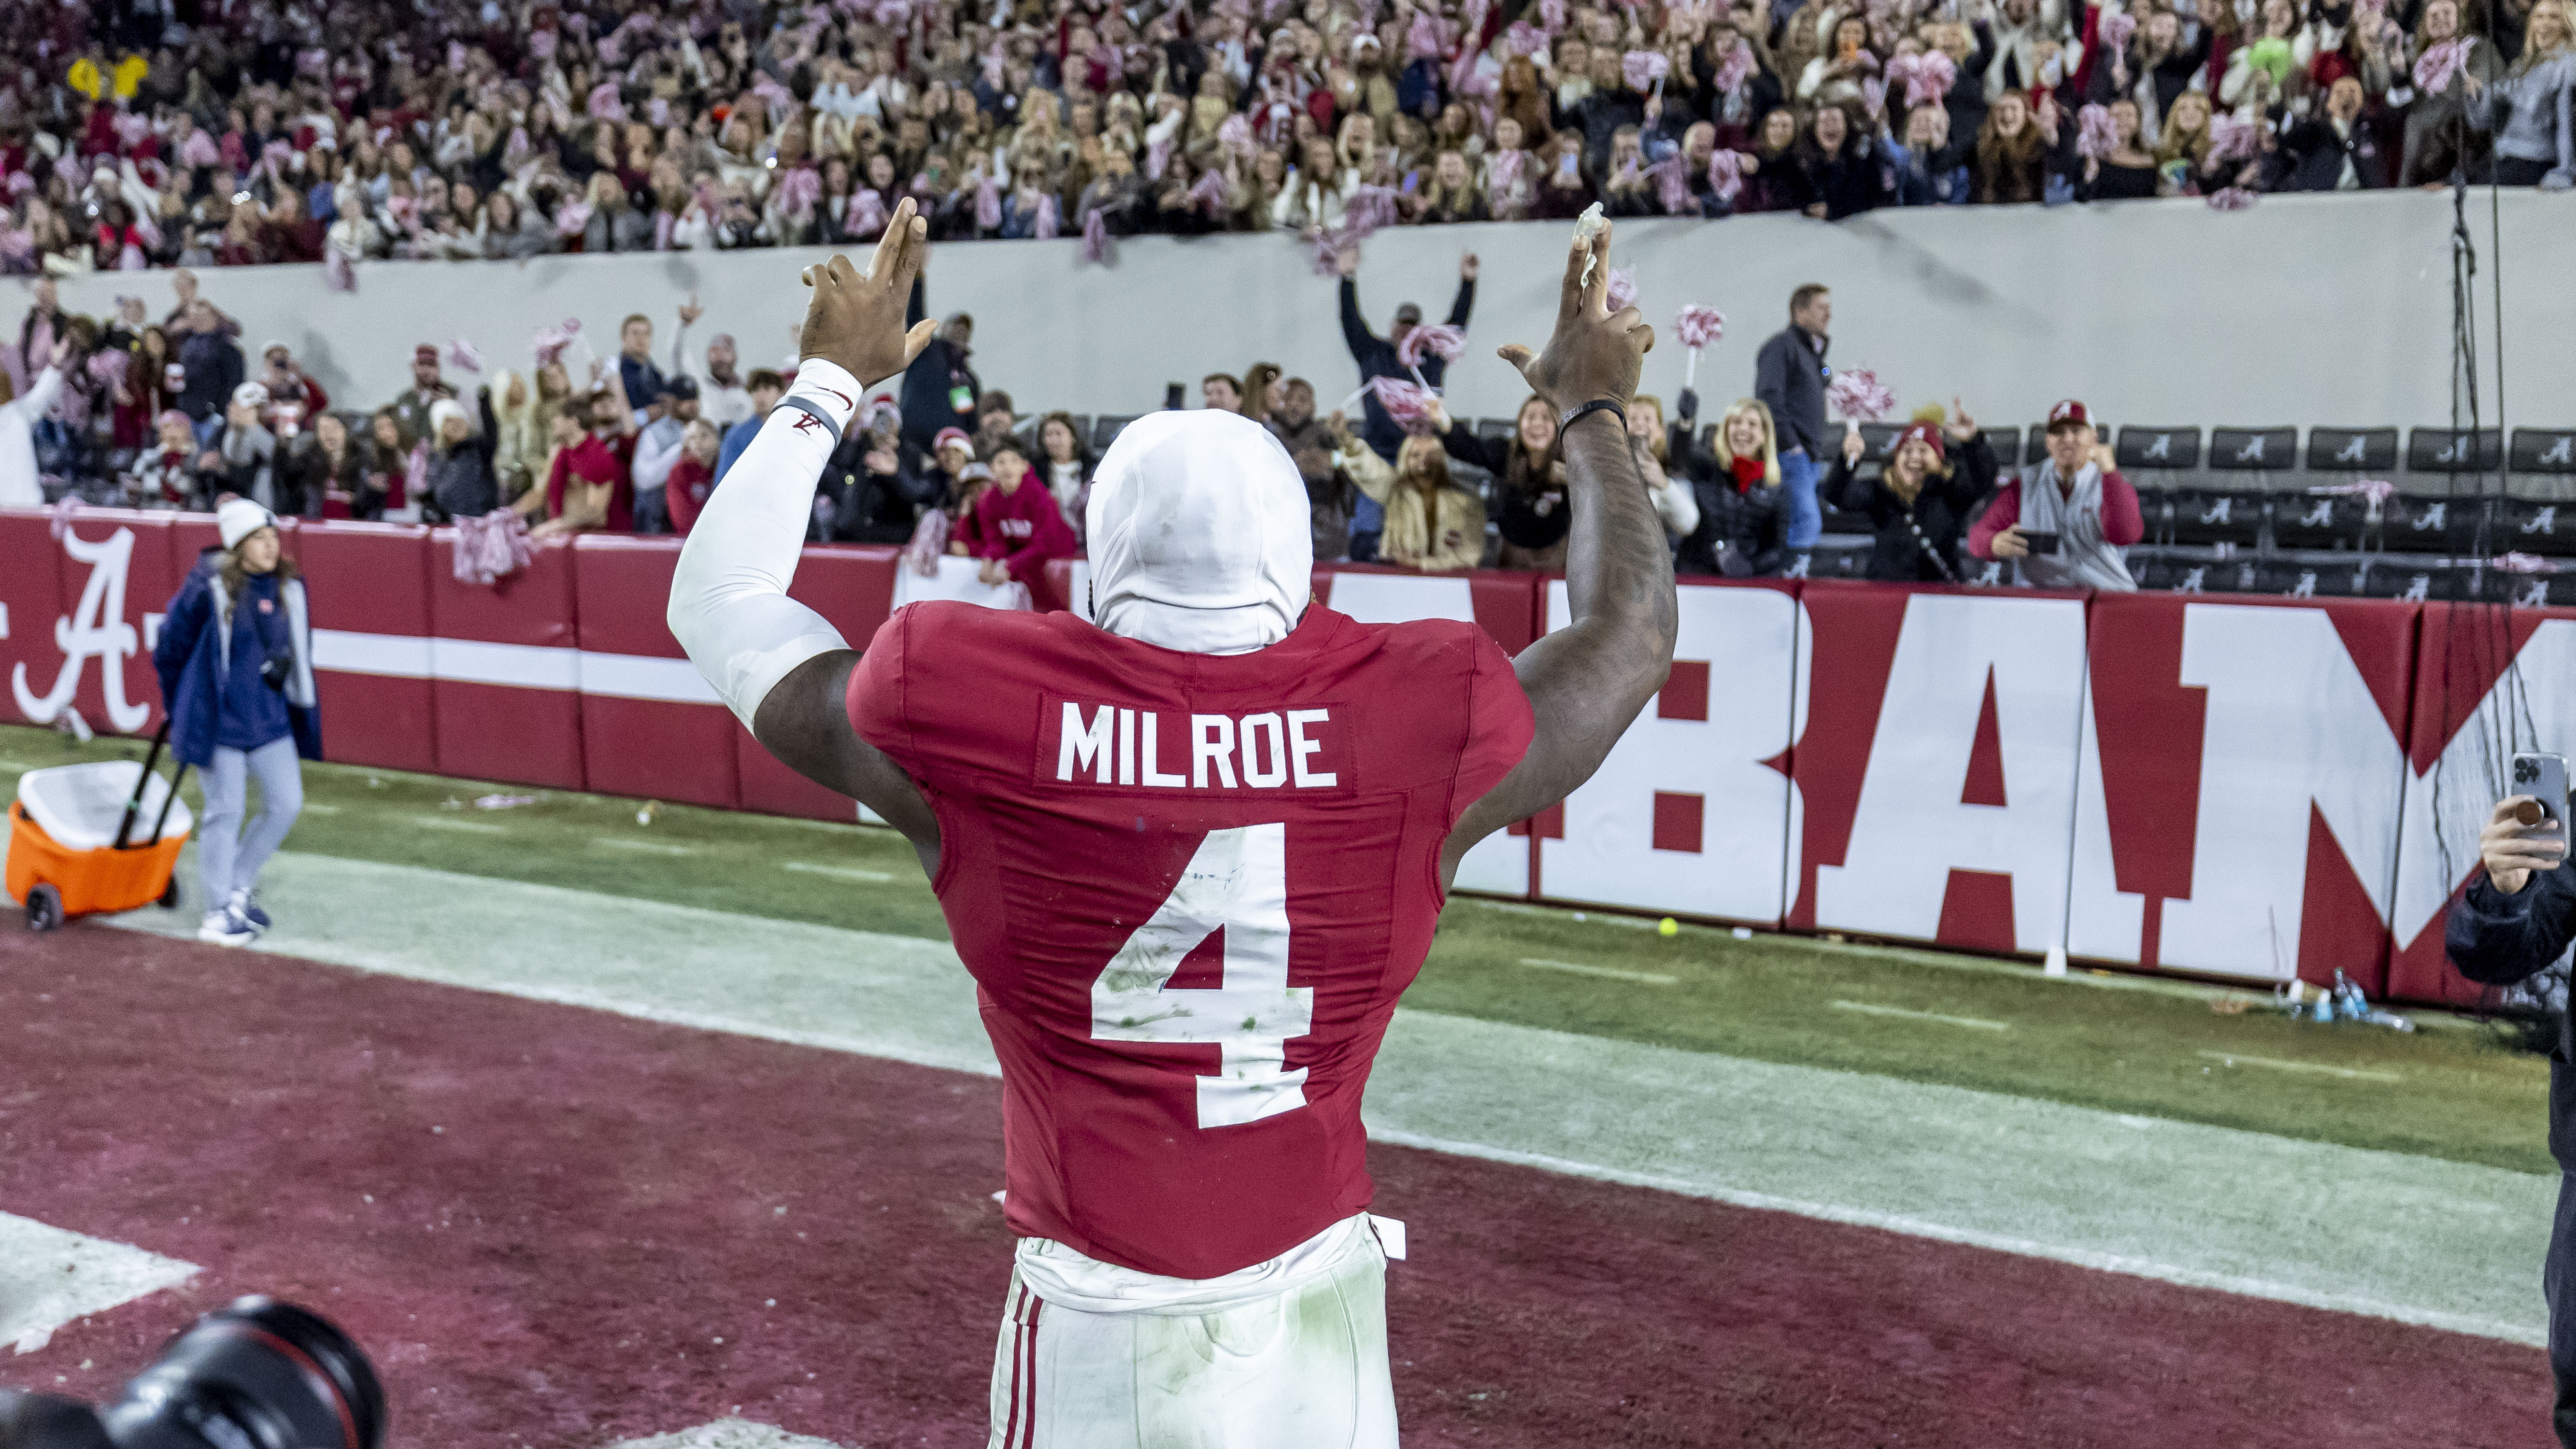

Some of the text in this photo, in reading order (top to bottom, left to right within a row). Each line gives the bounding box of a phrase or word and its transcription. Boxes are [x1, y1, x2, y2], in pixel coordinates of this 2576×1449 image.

[12, 526, 150, 731] A
[1057, 702, 1337, 788] MILROE
[1090, 822, 1313, 1129] 4
